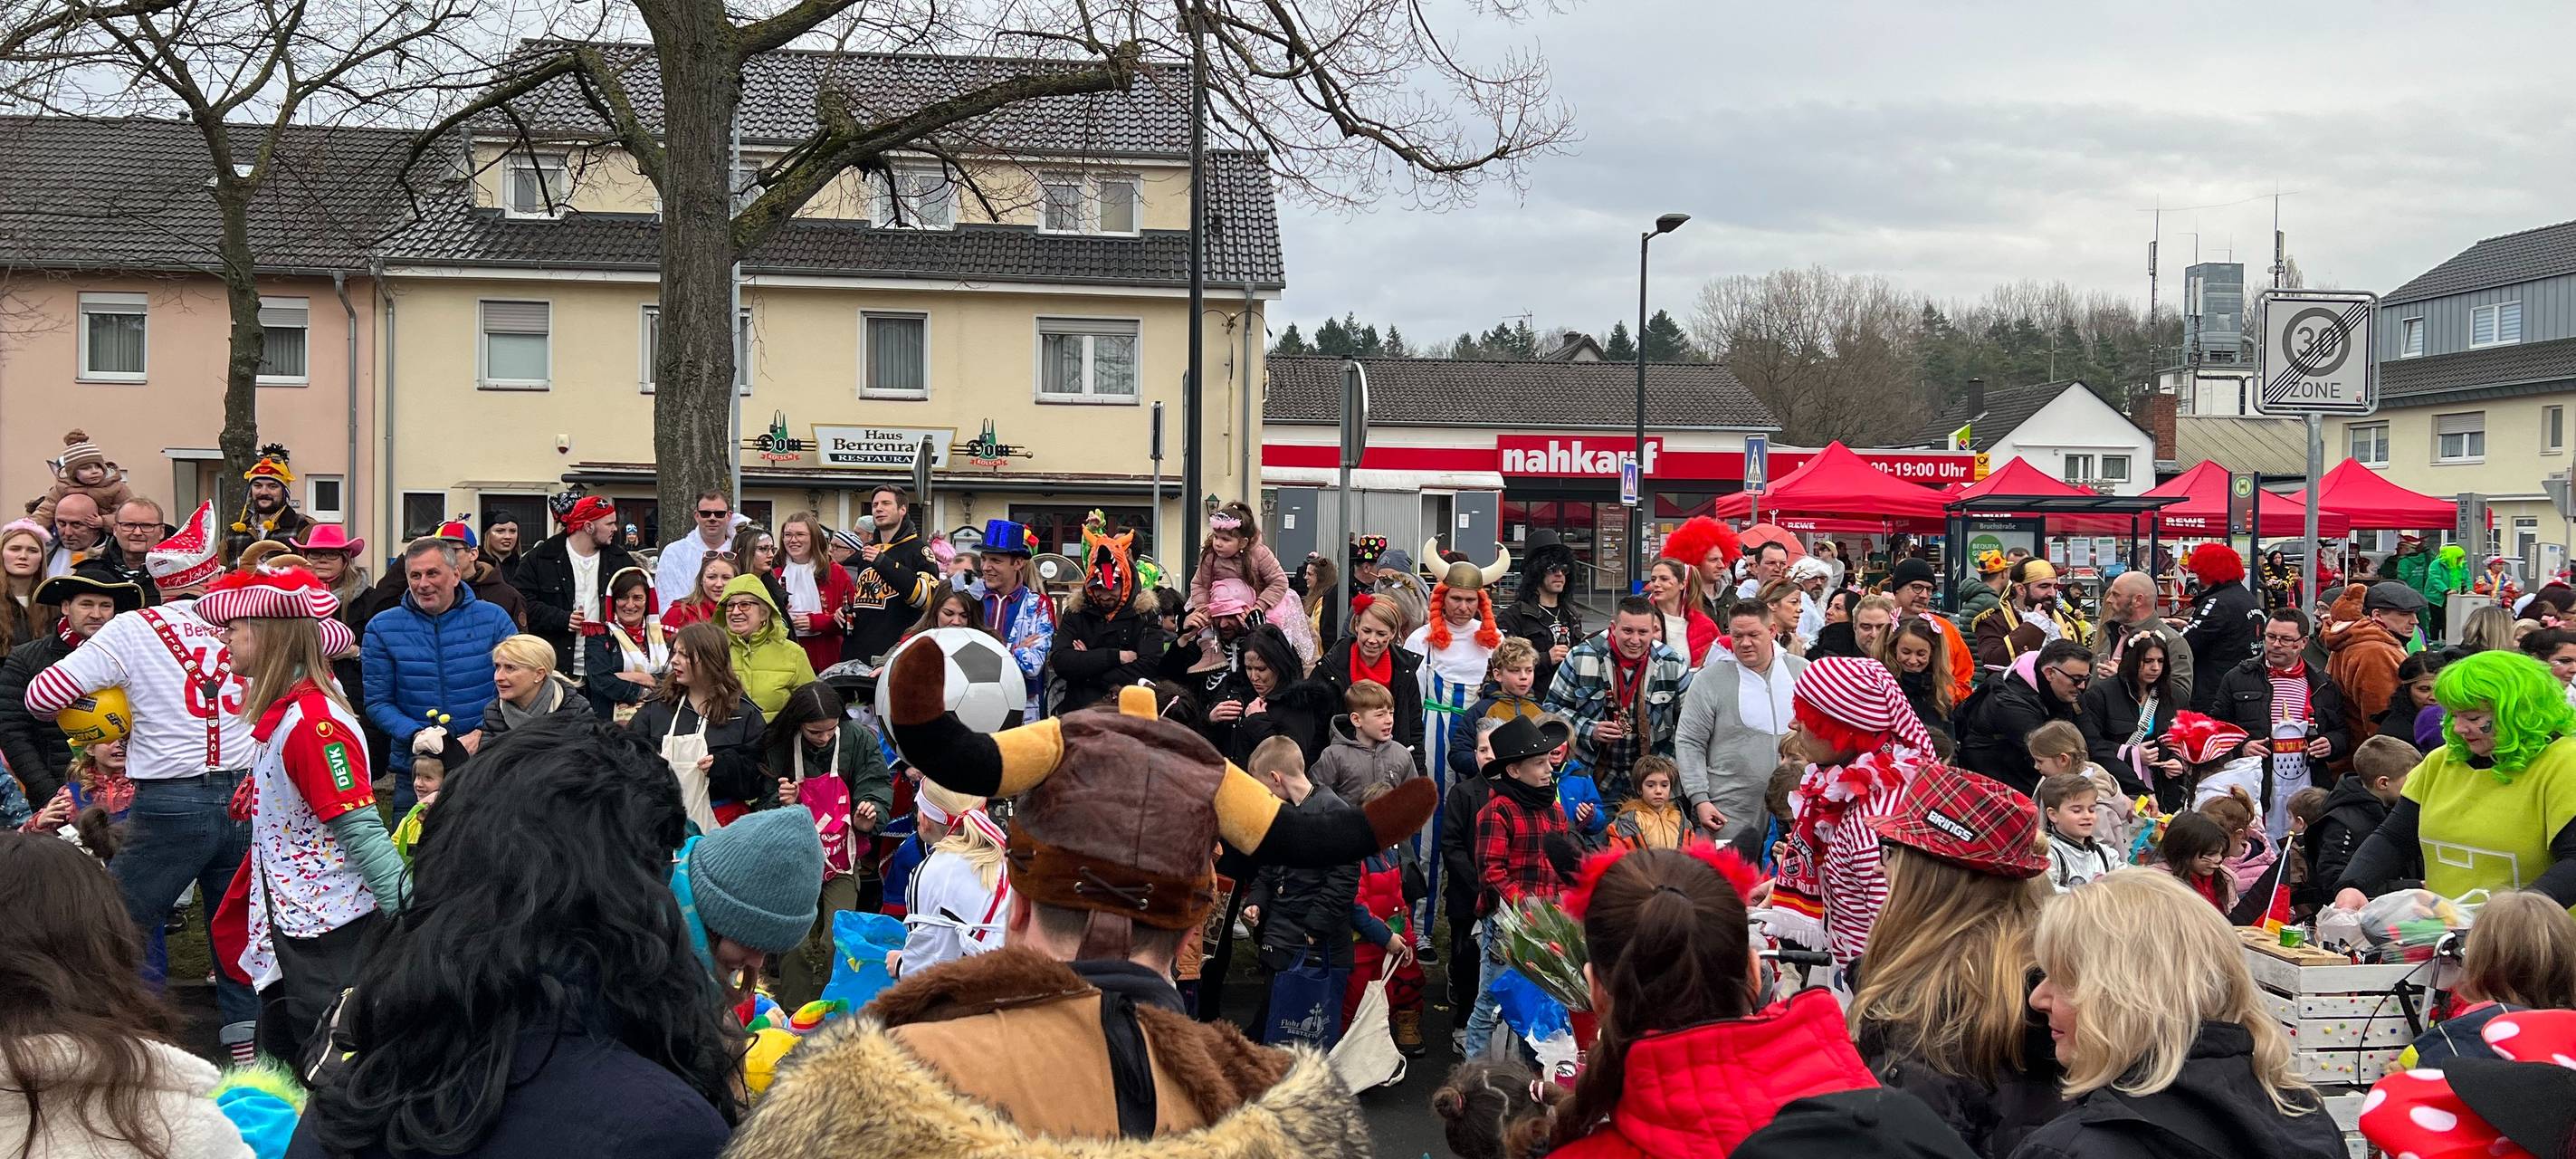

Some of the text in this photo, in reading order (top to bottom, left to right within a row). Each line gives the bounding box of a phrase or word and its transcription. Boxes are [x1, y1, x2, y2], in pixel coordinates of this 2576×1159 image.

[2296, 326, 2336, 358] 30
[2289, 380, 2342, 398] ZONE
[864, 429, 903, 441] Haus
[833, 437, 935, 453] Berrenra
[838, 455, 912, 463] RESTAURA
[1940, 462, 1967, 477] Uhr
[1788, 522, 1816, 530] REWE
[2166, 517, 2206, 528] REWE
[329, 747, 349, 787] DEVK
[1927, 809, 1973, 842] BRINGS
